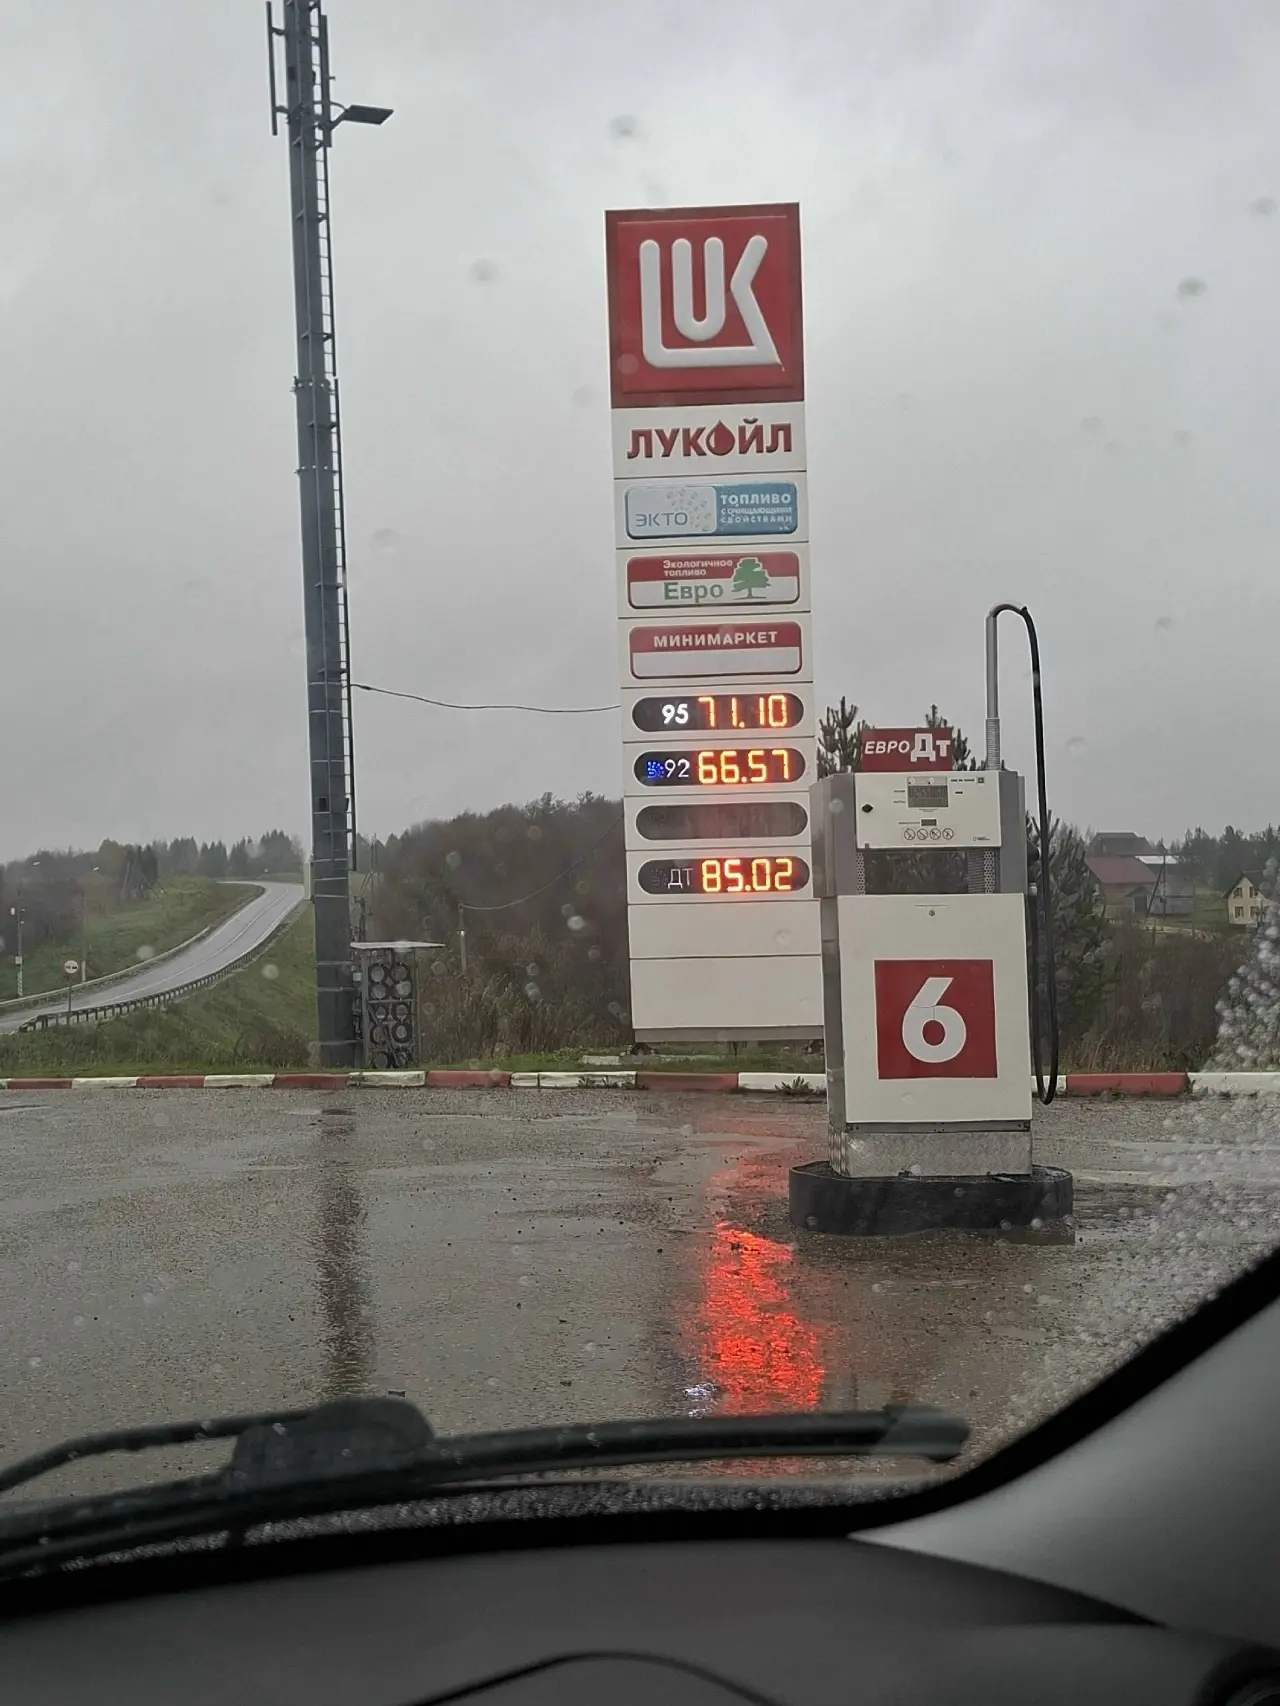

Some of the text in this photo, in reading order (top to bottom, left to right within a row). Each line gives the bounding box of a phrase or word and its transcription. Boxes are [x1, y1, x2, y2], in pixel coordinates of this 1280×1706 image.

[626, 417, 793, 460] ЛУКОЙЛ
[720, 493, 791, 506] ТОПЛИВО
[635, 511, 688, 528] ЭКТО
[663, 560, 733, 569] Экологичное
[664, 569, 707, 577] топливо
[664, 581, 724, 603] Евро
[653, 631, 778, 648] МИНИМАРКЕТ
[661, 694, 788, 728] 95 71.10
[864, 740, 910, 754] ЕВРО
[664, 749, 790, 784] 92 66.57
[667, 858, 793, 892] ДТ 85.02
[902, 977, 966, 1063] 6
